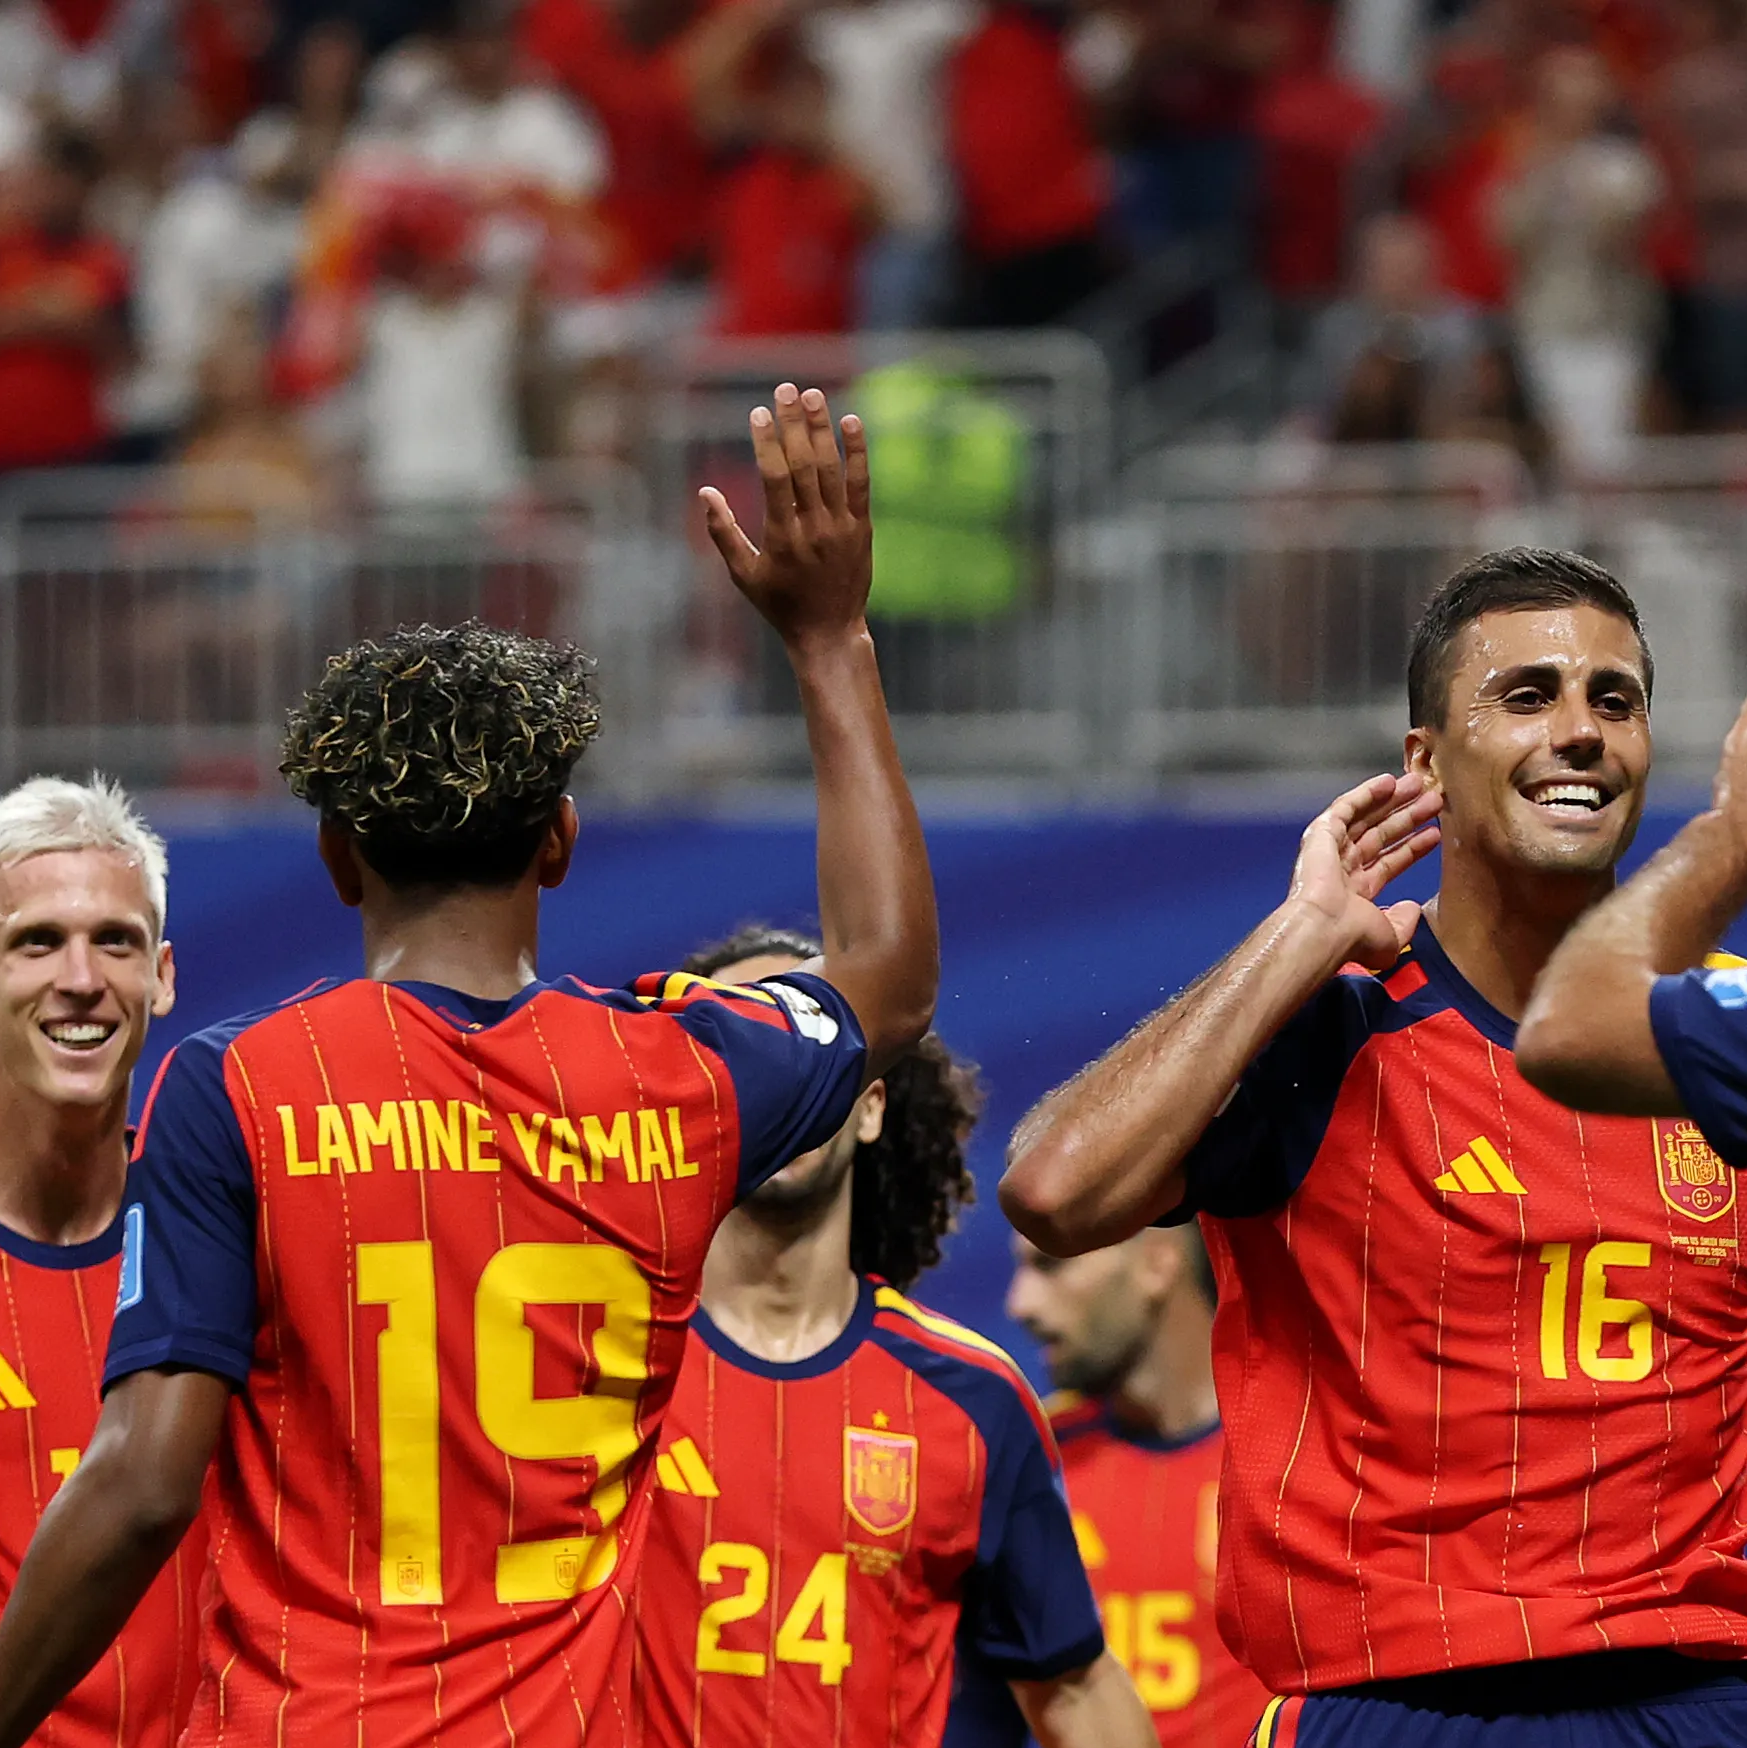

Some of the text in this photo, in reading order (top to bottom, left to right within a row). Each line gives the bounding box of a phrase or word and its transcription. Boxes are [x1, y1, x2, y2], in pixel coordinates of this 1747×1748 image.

[275, 1098, 700, 1184] LAMINE YAMAL
[1539, 1240, 1654, 1383] 16
[355, 1239, 656, 1606] 19
[695, 1541, 852, 1686] 24
[1102, 1590, 1201, 1712] 15
